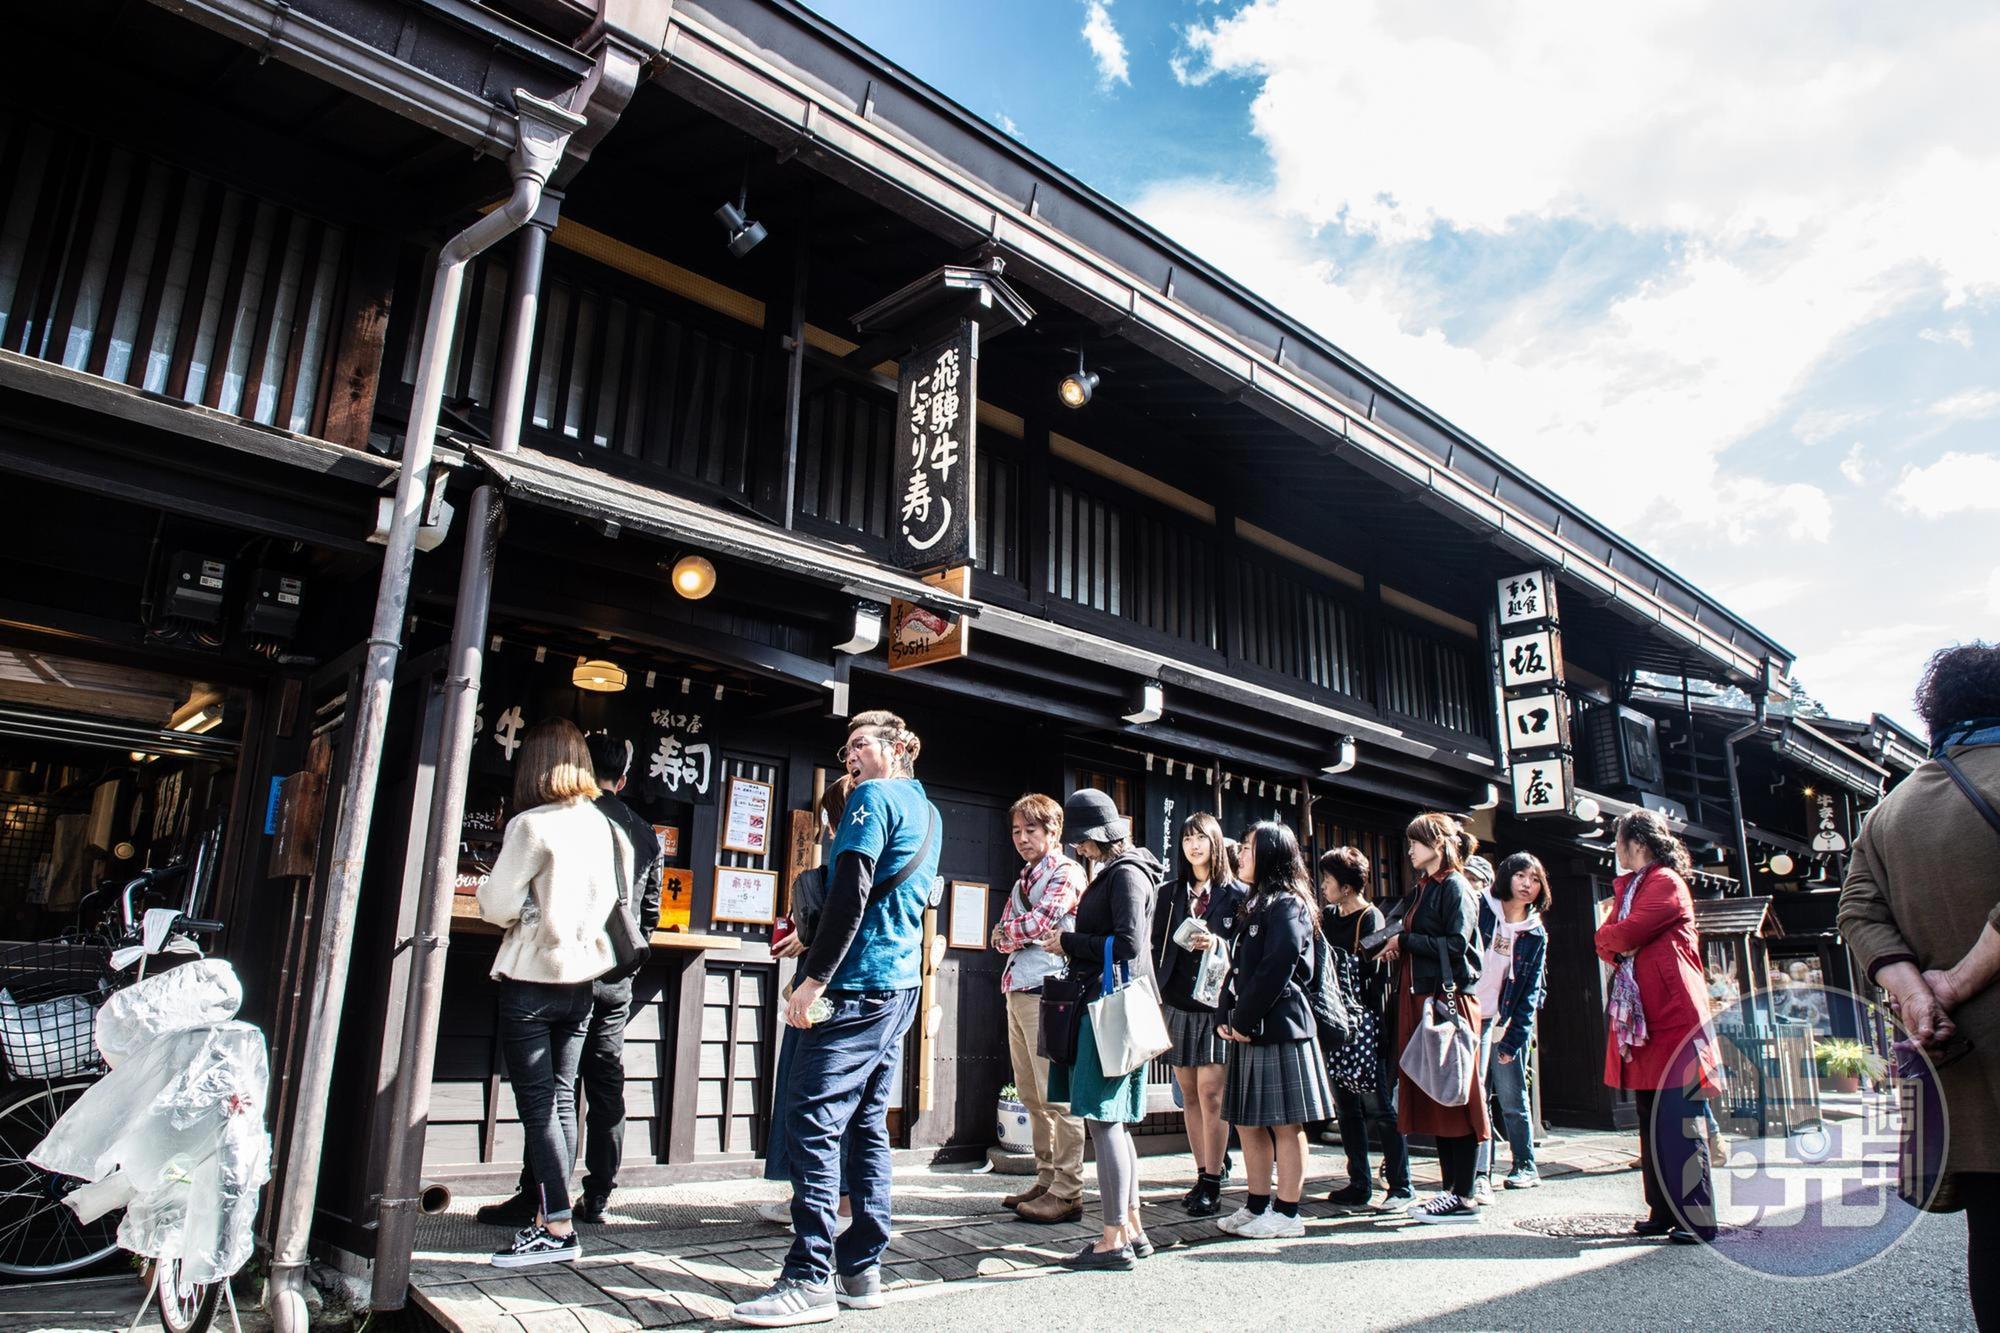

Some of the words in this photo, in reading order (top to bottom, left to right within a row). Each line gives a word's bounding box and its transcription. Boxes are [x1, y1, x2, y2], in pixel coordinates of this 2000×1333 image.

[931, 348, 960, 482] 飛騨牛
[649, 734, 712, 794] 寿司
[651, 708, 703, 734] 坂口屋
[1510, 643, 1553, 804] 坂口屋
